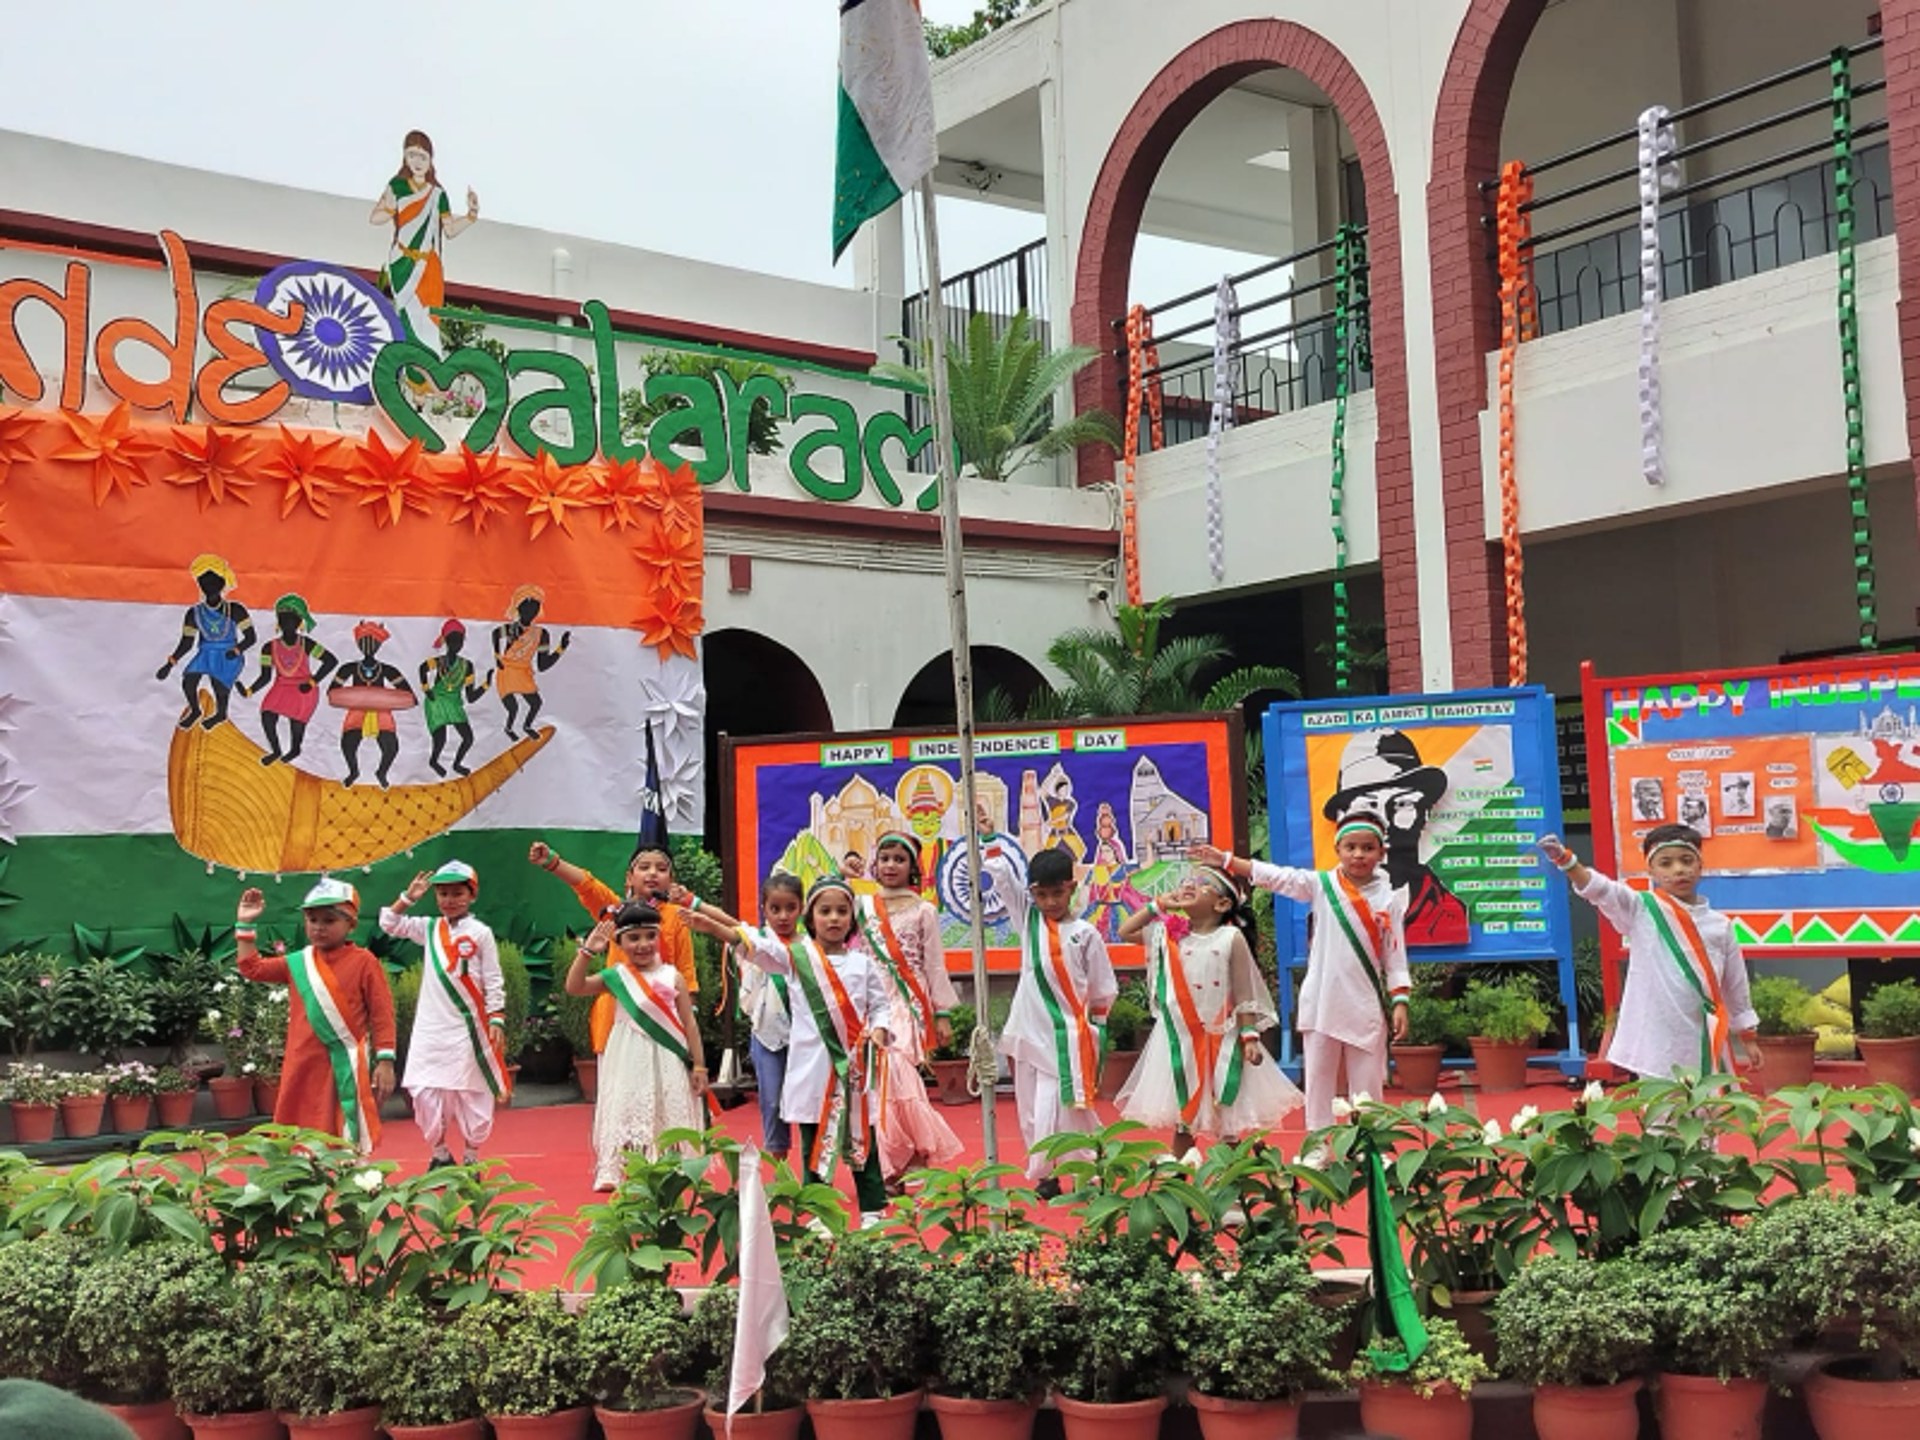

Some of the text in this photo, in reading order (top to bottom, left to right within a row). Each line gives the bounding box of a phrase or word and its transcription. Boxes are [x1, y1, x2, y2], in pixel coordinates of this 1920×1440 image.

[1306, 702, 1512, 726] AZADI KA AMRIT MAHOTSAV
[1611, 680, 1750, 722] HAPPY
[829, 733, 1119, 762] HAPPY INDEENDENCE DAY
